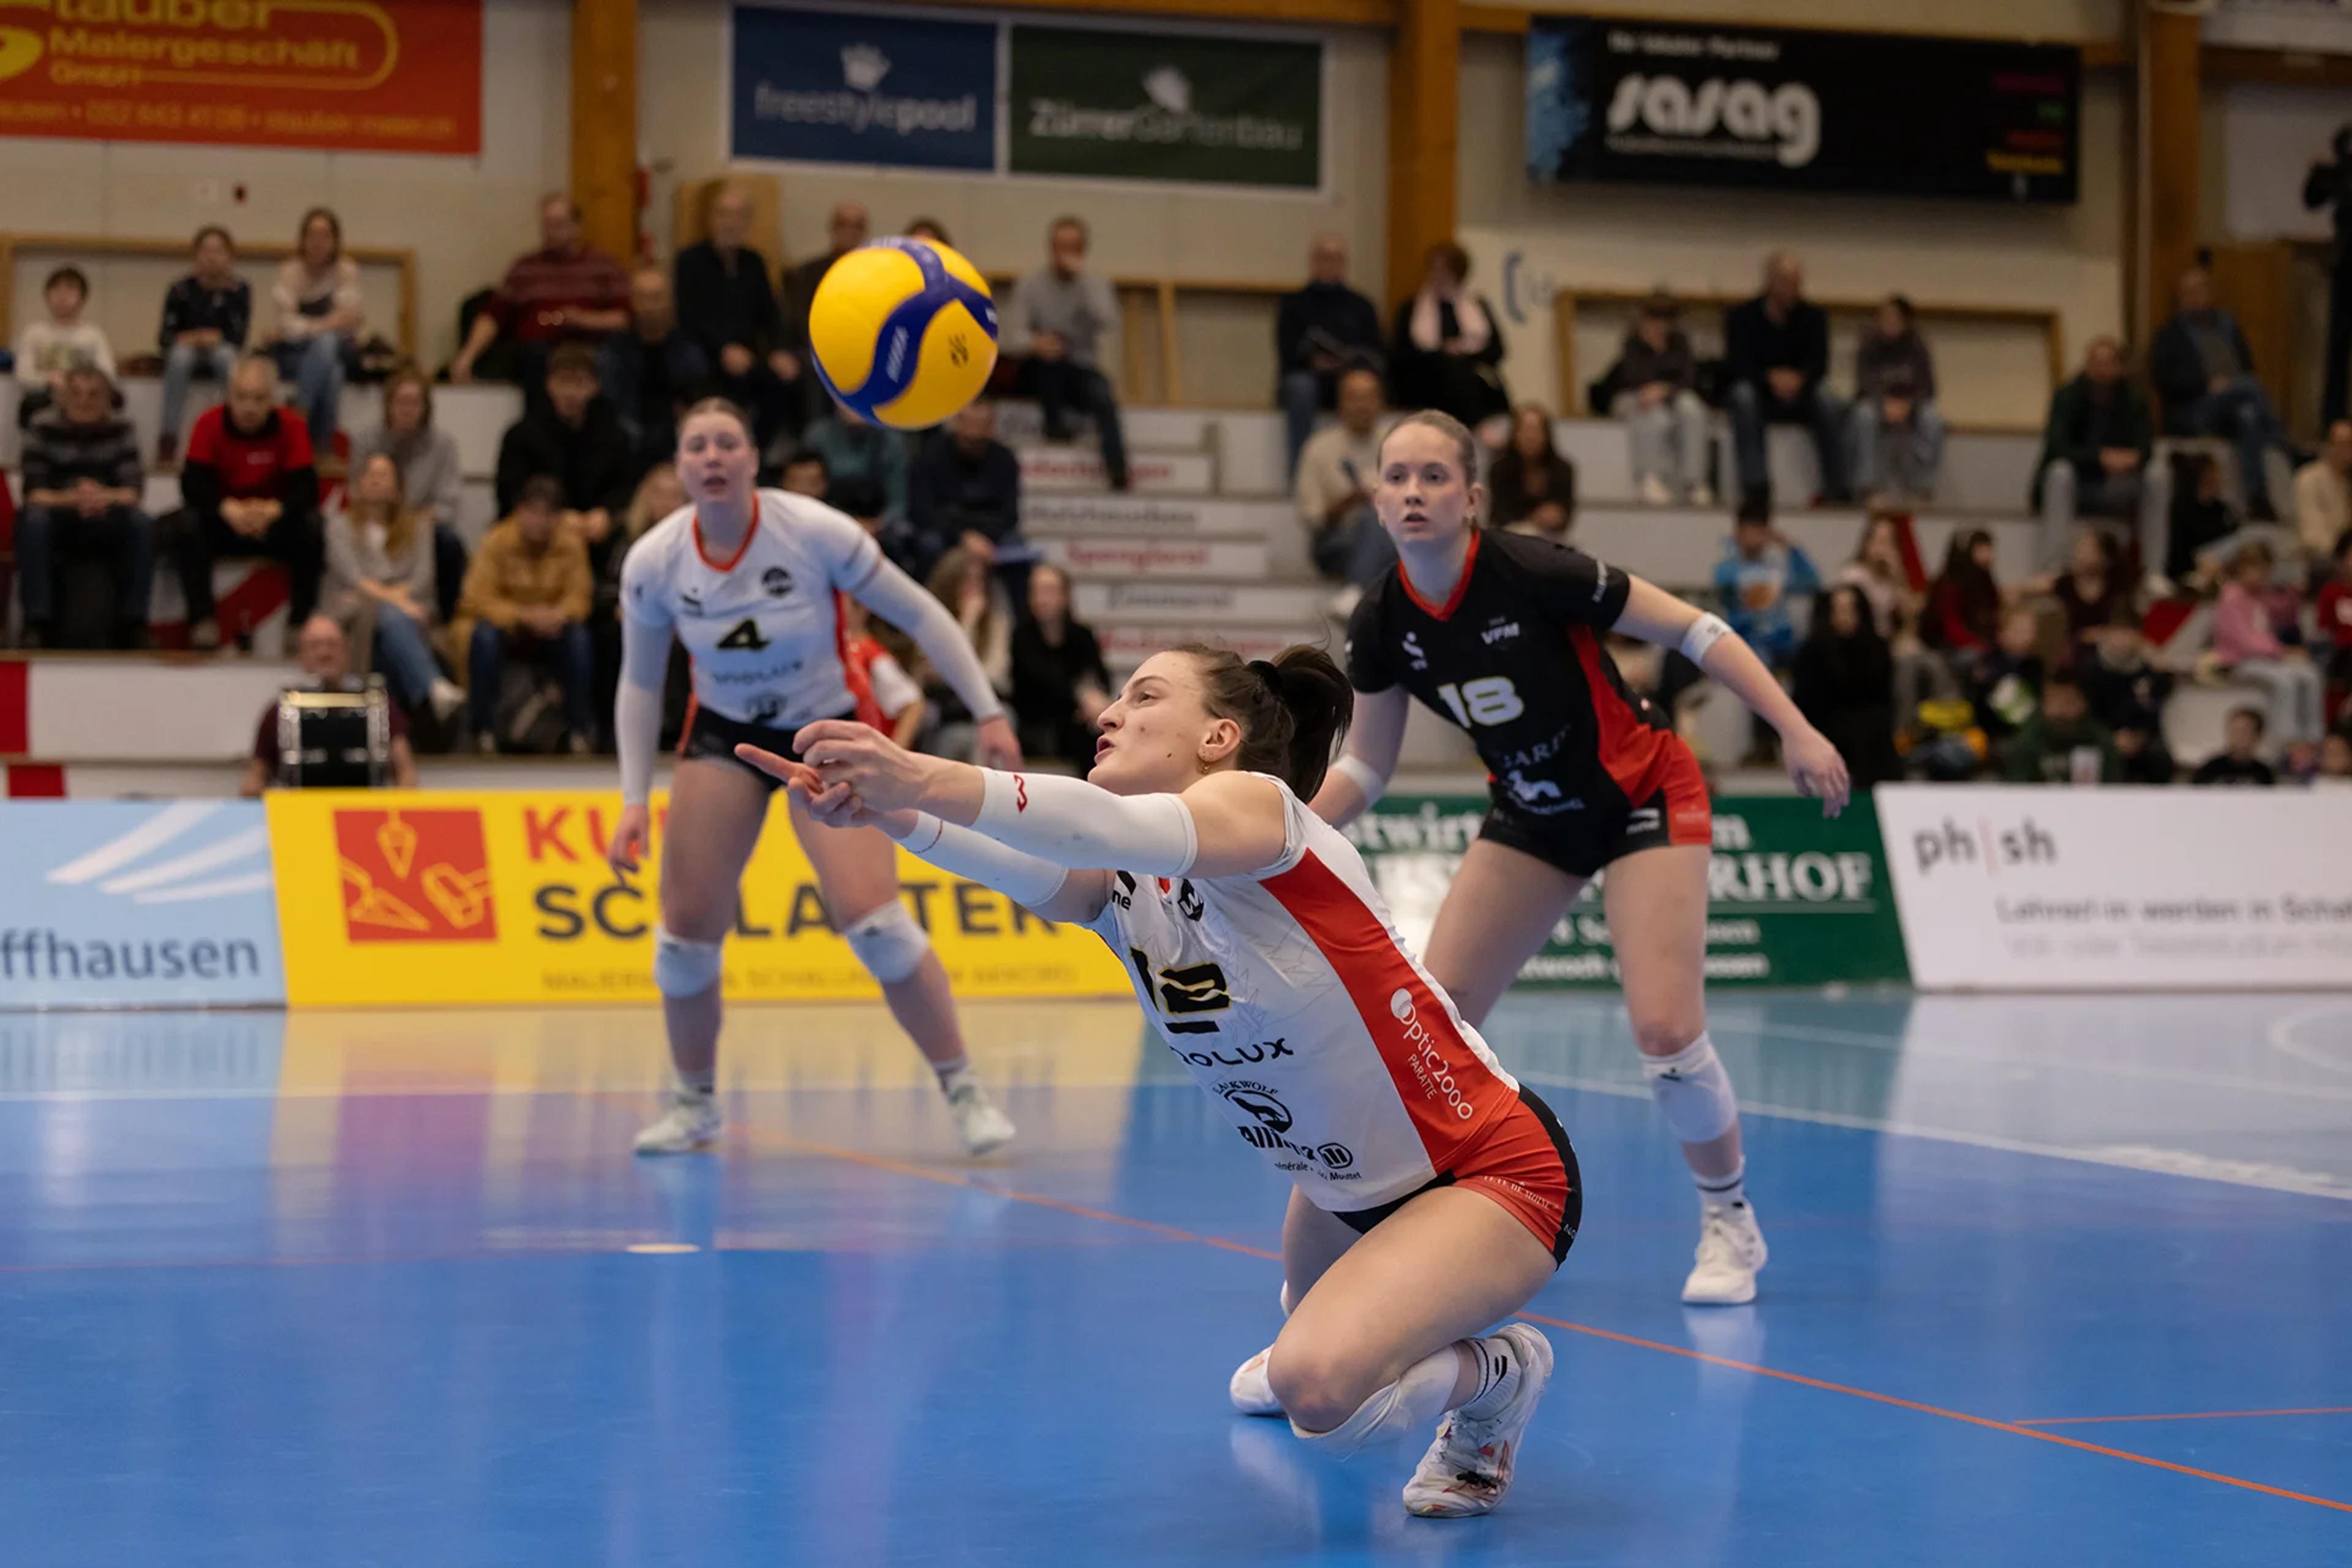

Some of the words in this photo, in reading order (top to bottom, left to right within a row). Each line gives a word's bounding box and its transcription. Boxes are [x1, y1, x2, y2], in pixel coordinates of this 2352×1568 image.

[1607, 72, 1821, 169] sasag
[715, 618, 771, 651] 4
[1437, 676, 1525, 728] 18
[0, 927, 261, 981] ffhausen
[1407, 1054, 1438, 1100] PARATTE
